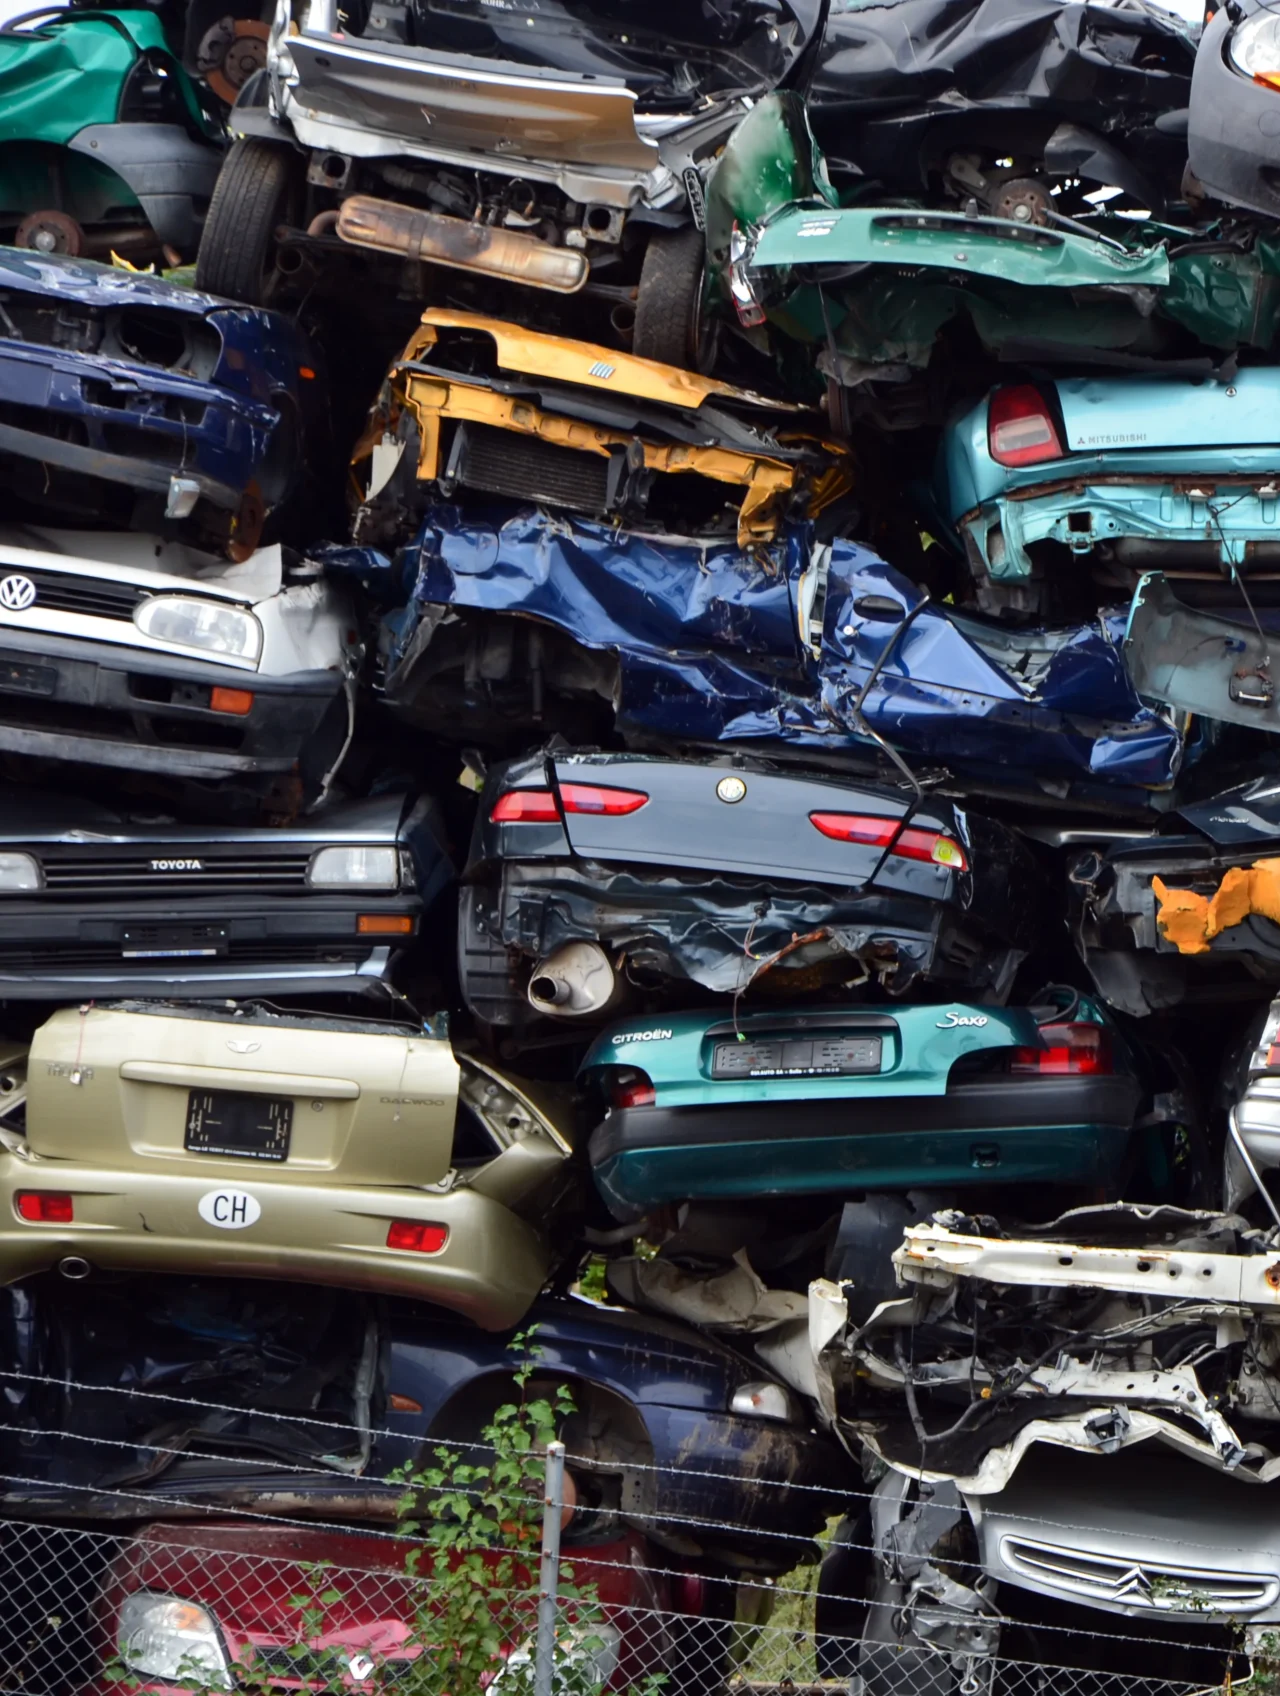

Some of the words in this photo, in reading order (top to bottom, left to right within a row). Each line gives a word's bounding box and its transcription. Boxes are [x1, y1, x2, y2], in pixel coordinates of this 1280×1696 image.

[1088, 433, 1147, 444] MITSUBISHI
[0, 575, 36, 610] VW
[151, 860, 202, 870] TOYOTA
[935, 1012, 988, 1028] Saxo
[611, 1028, 673, 1044] CITROËN
[380, 1097, 445, 1107] DAEWOO
[213, 1195, 247, 1223] CH
